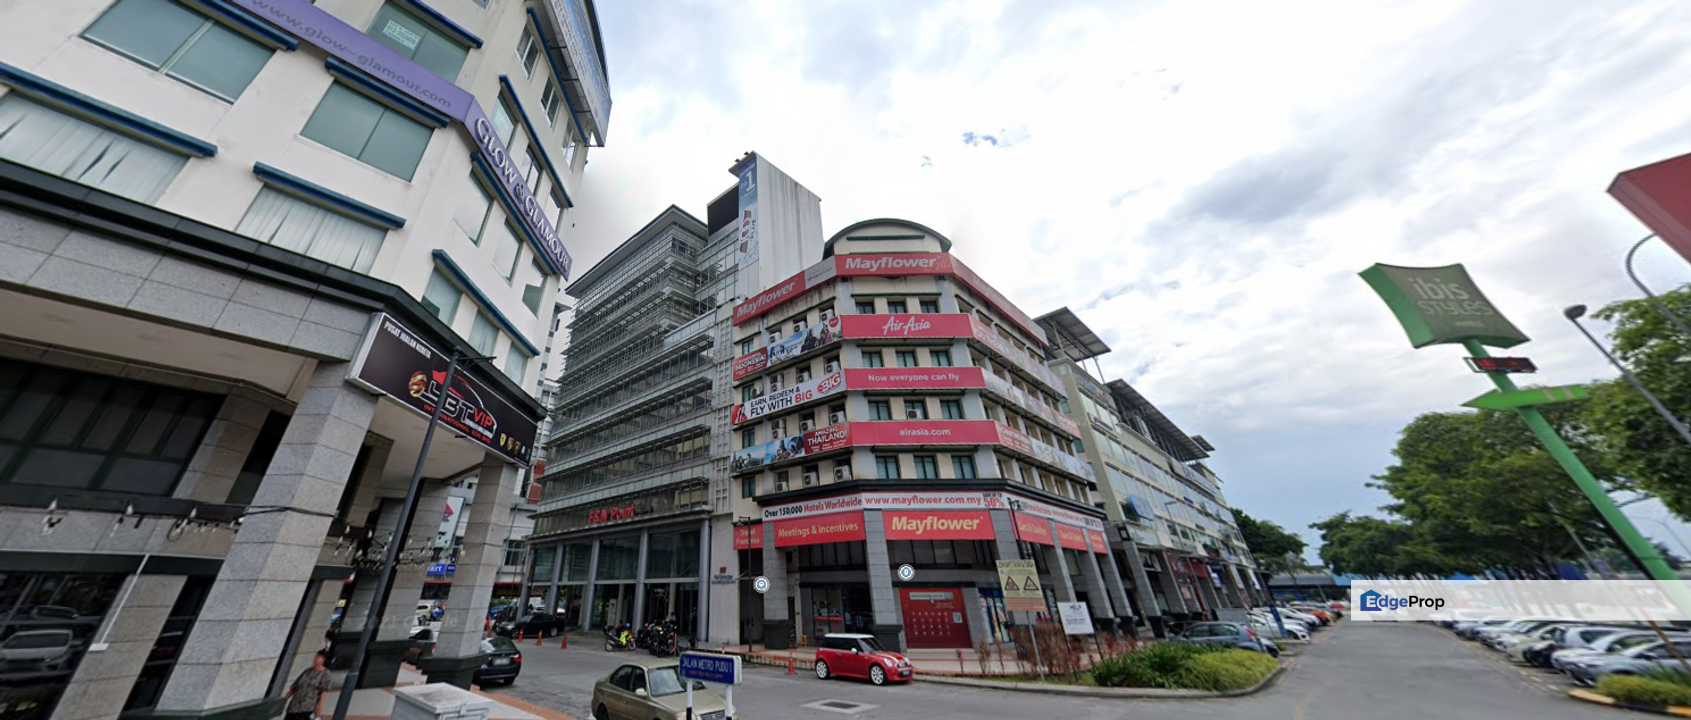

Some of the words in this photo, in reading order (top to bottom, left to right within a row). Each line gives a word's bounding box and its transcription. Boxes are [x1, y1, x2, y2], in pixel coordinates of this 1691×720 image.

[475, 117, 517, 184] GLOW
[514, 183, 525, 203] &
[525, 195, 569, 272] GLAMOUR
[845, 256, 937, 271] Mayflower
[1408, 277, 1469, 300] ibis
[736, 281, 795, 318] Mayflower
[882, 315, 932, 336] AirAsia
[868, 374, 887, 382] Now
[889, 374, 929, 382] everyone
[931, 373, 946, 381] can
[948, 373, 959, 382] fly
[750, 404, 768, 418] FLY
[767, 396, 792, 412] WITH
[794, 390, 813, 403] BIG
[474, 407, 494, 428] VIP
[900, 428, 950, 436] airasia.com
[764, 509, 779, 518] Over
[779, 505, 803, 516] 150,000
[803, 503, 825, 513] Hotels
[825, 498, 862, 510] Worldwide
[864, 495, 981, 506] www.mayflower.com.my
[587, 508, 608, 525] F&N
[610, 503, 636, 520] Point
[740, 528, 756, 536] Trael
[778, 526, 810, 538] Meetings
[810, 525, 817, 534] &
[818, 521, 859, 534] Incentives
[891, 516, 980, 535] Mayflower
[735, 537, 760, 546] Francise
[682, 657, 698, 668] JALAN
